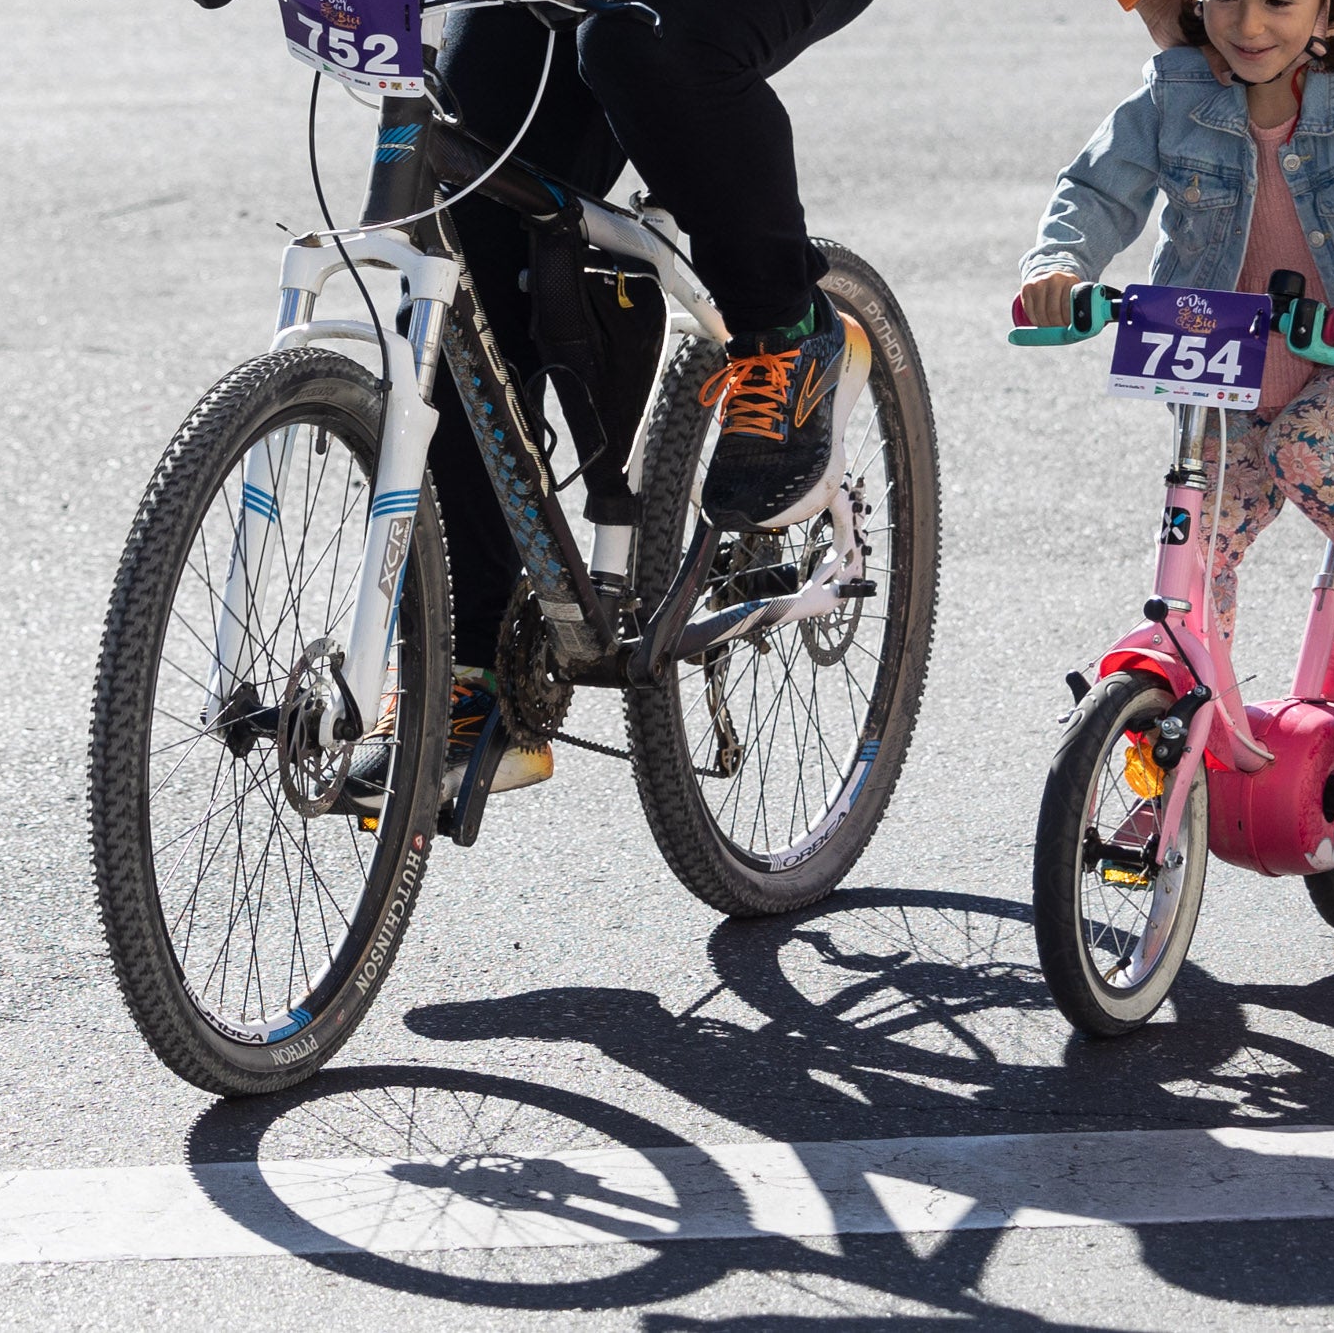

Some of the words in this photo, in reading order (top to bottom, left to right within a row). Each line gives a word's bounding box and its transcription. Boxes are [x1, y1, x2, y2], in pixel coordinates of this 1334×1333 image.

[297, 12, 400, 74] 752
[863, 300, 908, 374] PYTHON
[1193, 314, 1218, 329] Bici
[1141, 331, 1242, 383] 754
[380, 521, 404, 591] XCR
[783, 811, 847, 868] ORBEA
[355, 849, 421, 996] HUTCHINSON
[269, 1033, 319, 1066] PYTHON
